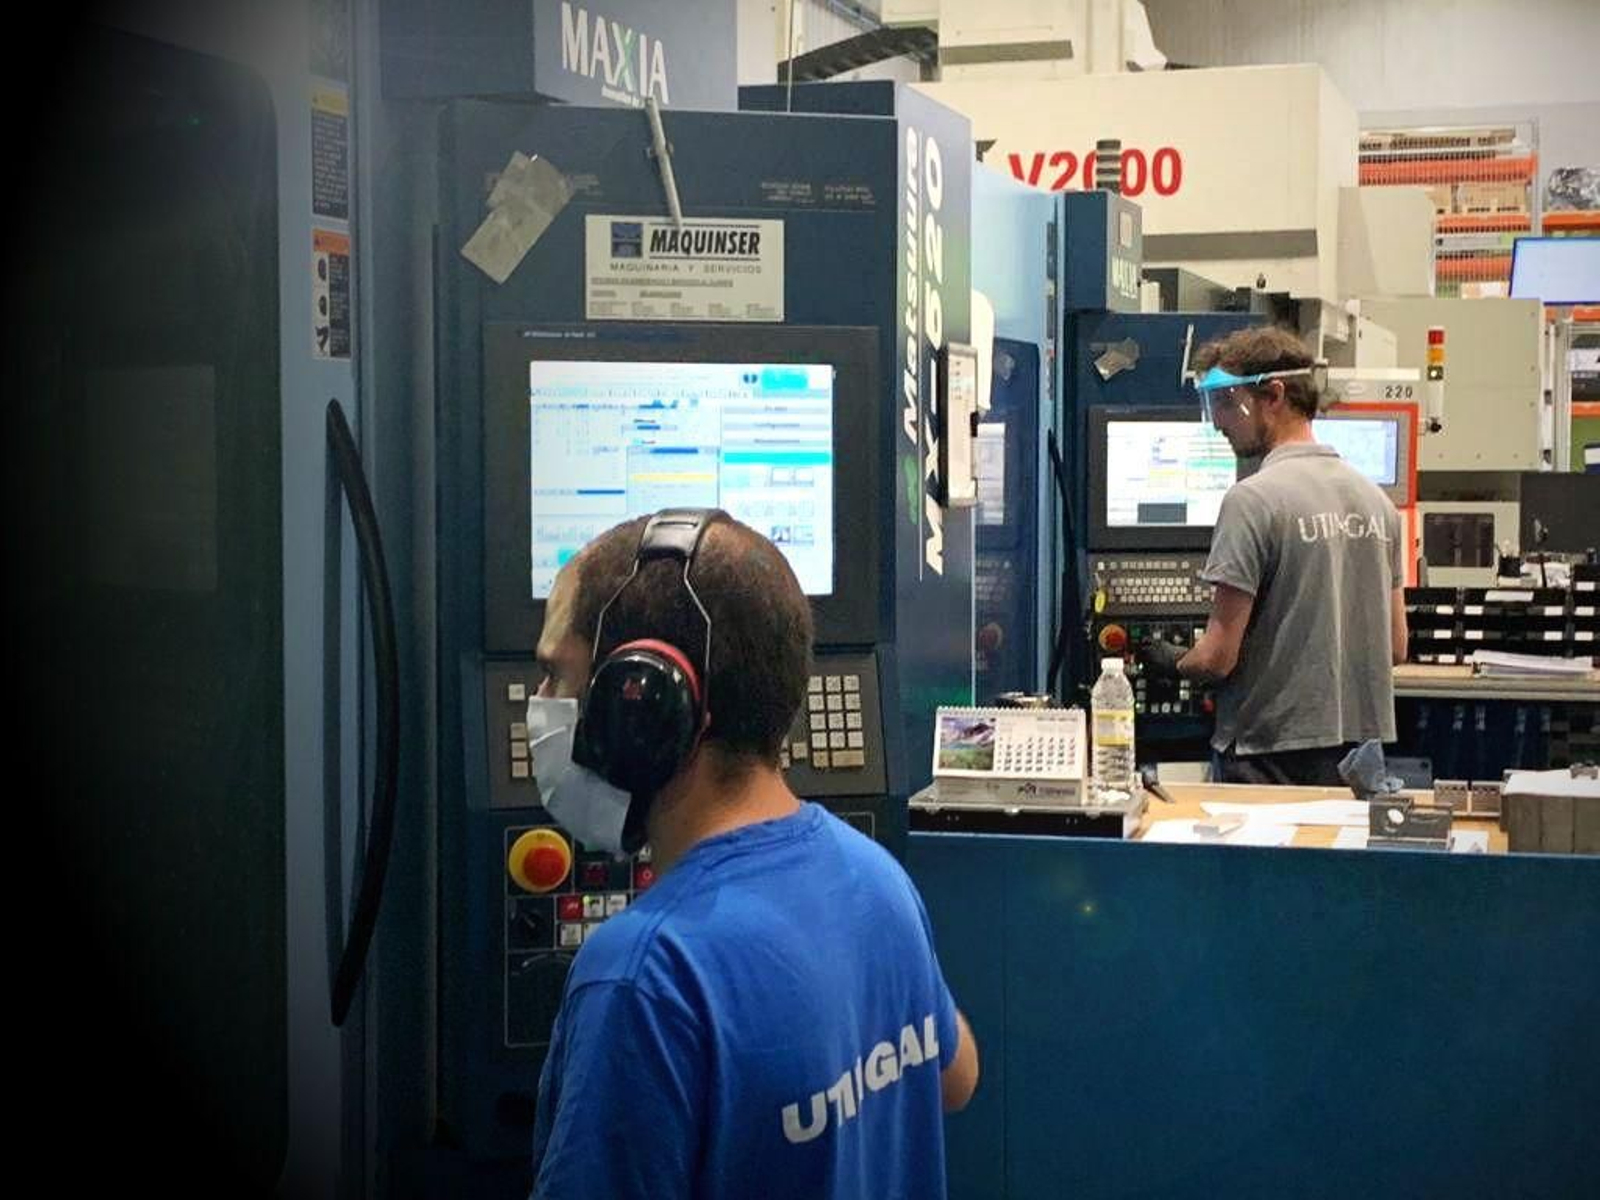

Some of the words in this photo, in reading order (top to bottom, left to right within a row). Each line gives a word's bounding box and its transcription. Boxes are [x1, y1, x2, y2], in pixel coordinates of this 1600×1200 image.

[562, 2, 669, 105] MAXIA
[650, 229, 761, 256] MAQUINSER
[610, 263, 679, 273] MAQUINARIA
[688, 265, 695, 273] Y
[704, 264, 762, 275] SERVICIOS
[1385, 385, 1413, 399] 220
